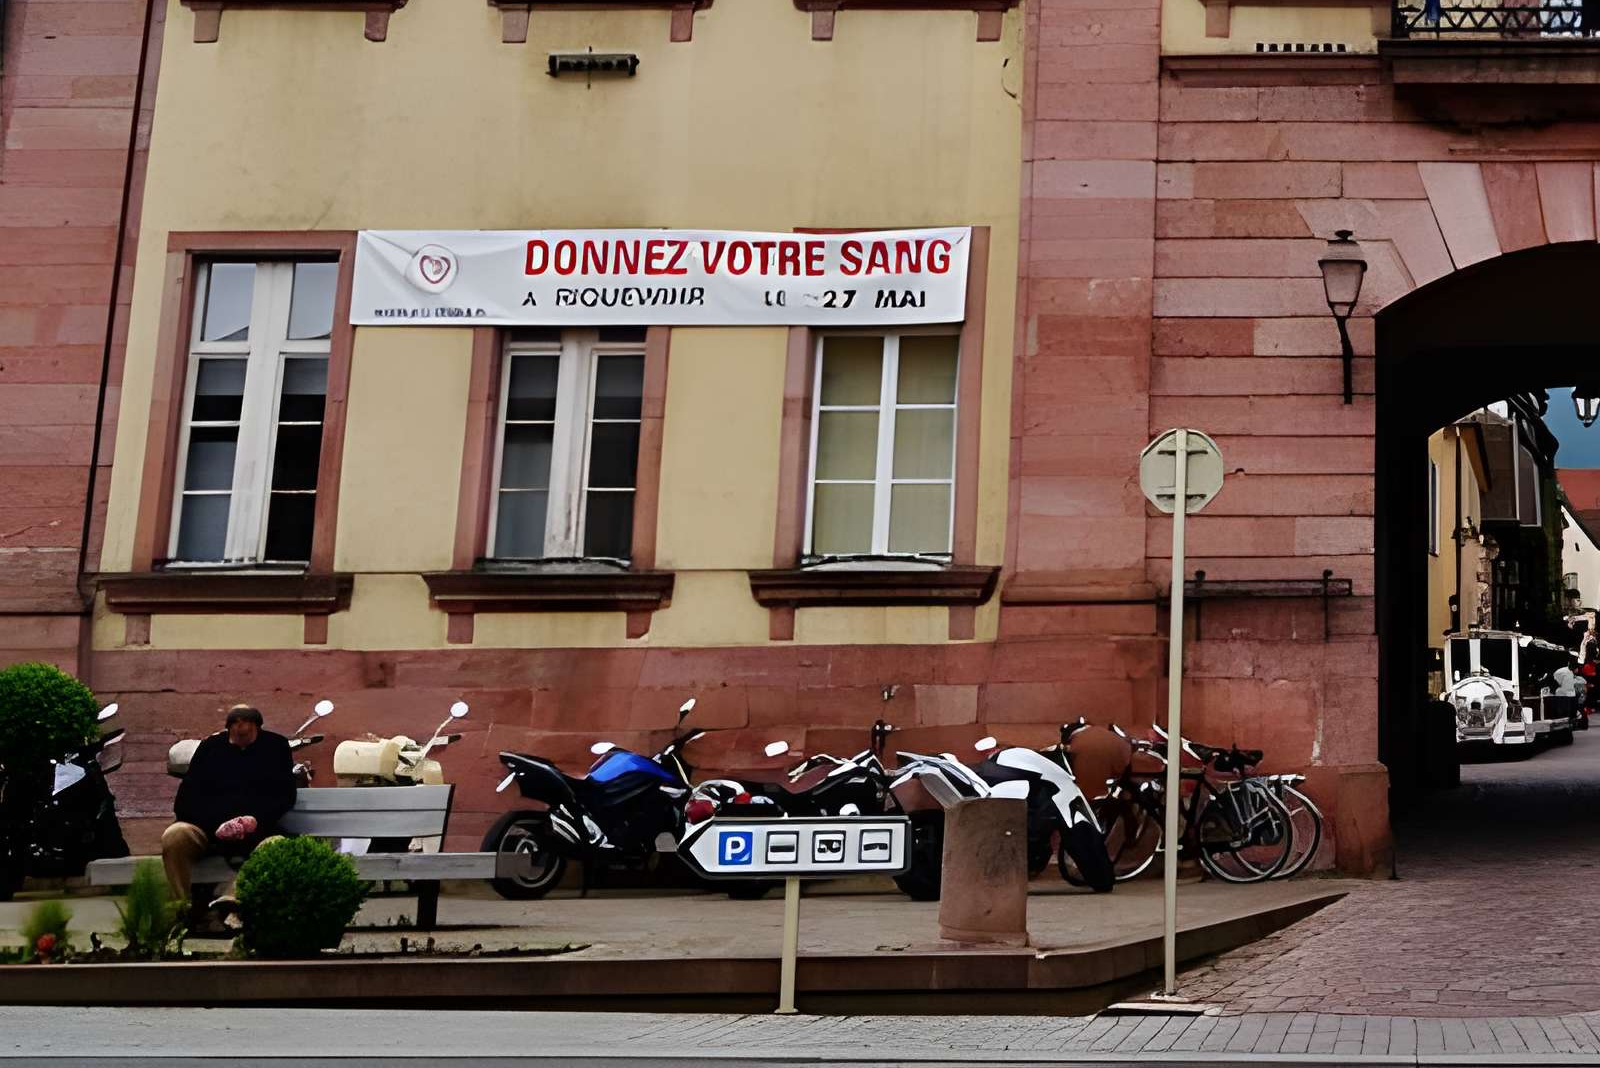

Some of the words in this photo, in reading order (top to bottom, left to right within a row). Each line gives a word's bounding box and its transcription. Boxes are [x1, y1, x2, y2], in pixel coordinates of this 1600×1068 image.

[525, 239, 688, 276] DONNEZ
[702, 240, 825, 276] VOTRE
[840, 239, 951, 276] SANG
[824, 290, 857, 309] 27
[875, 290, 926, 309] MAI
[725, 836, 746, 862] P
